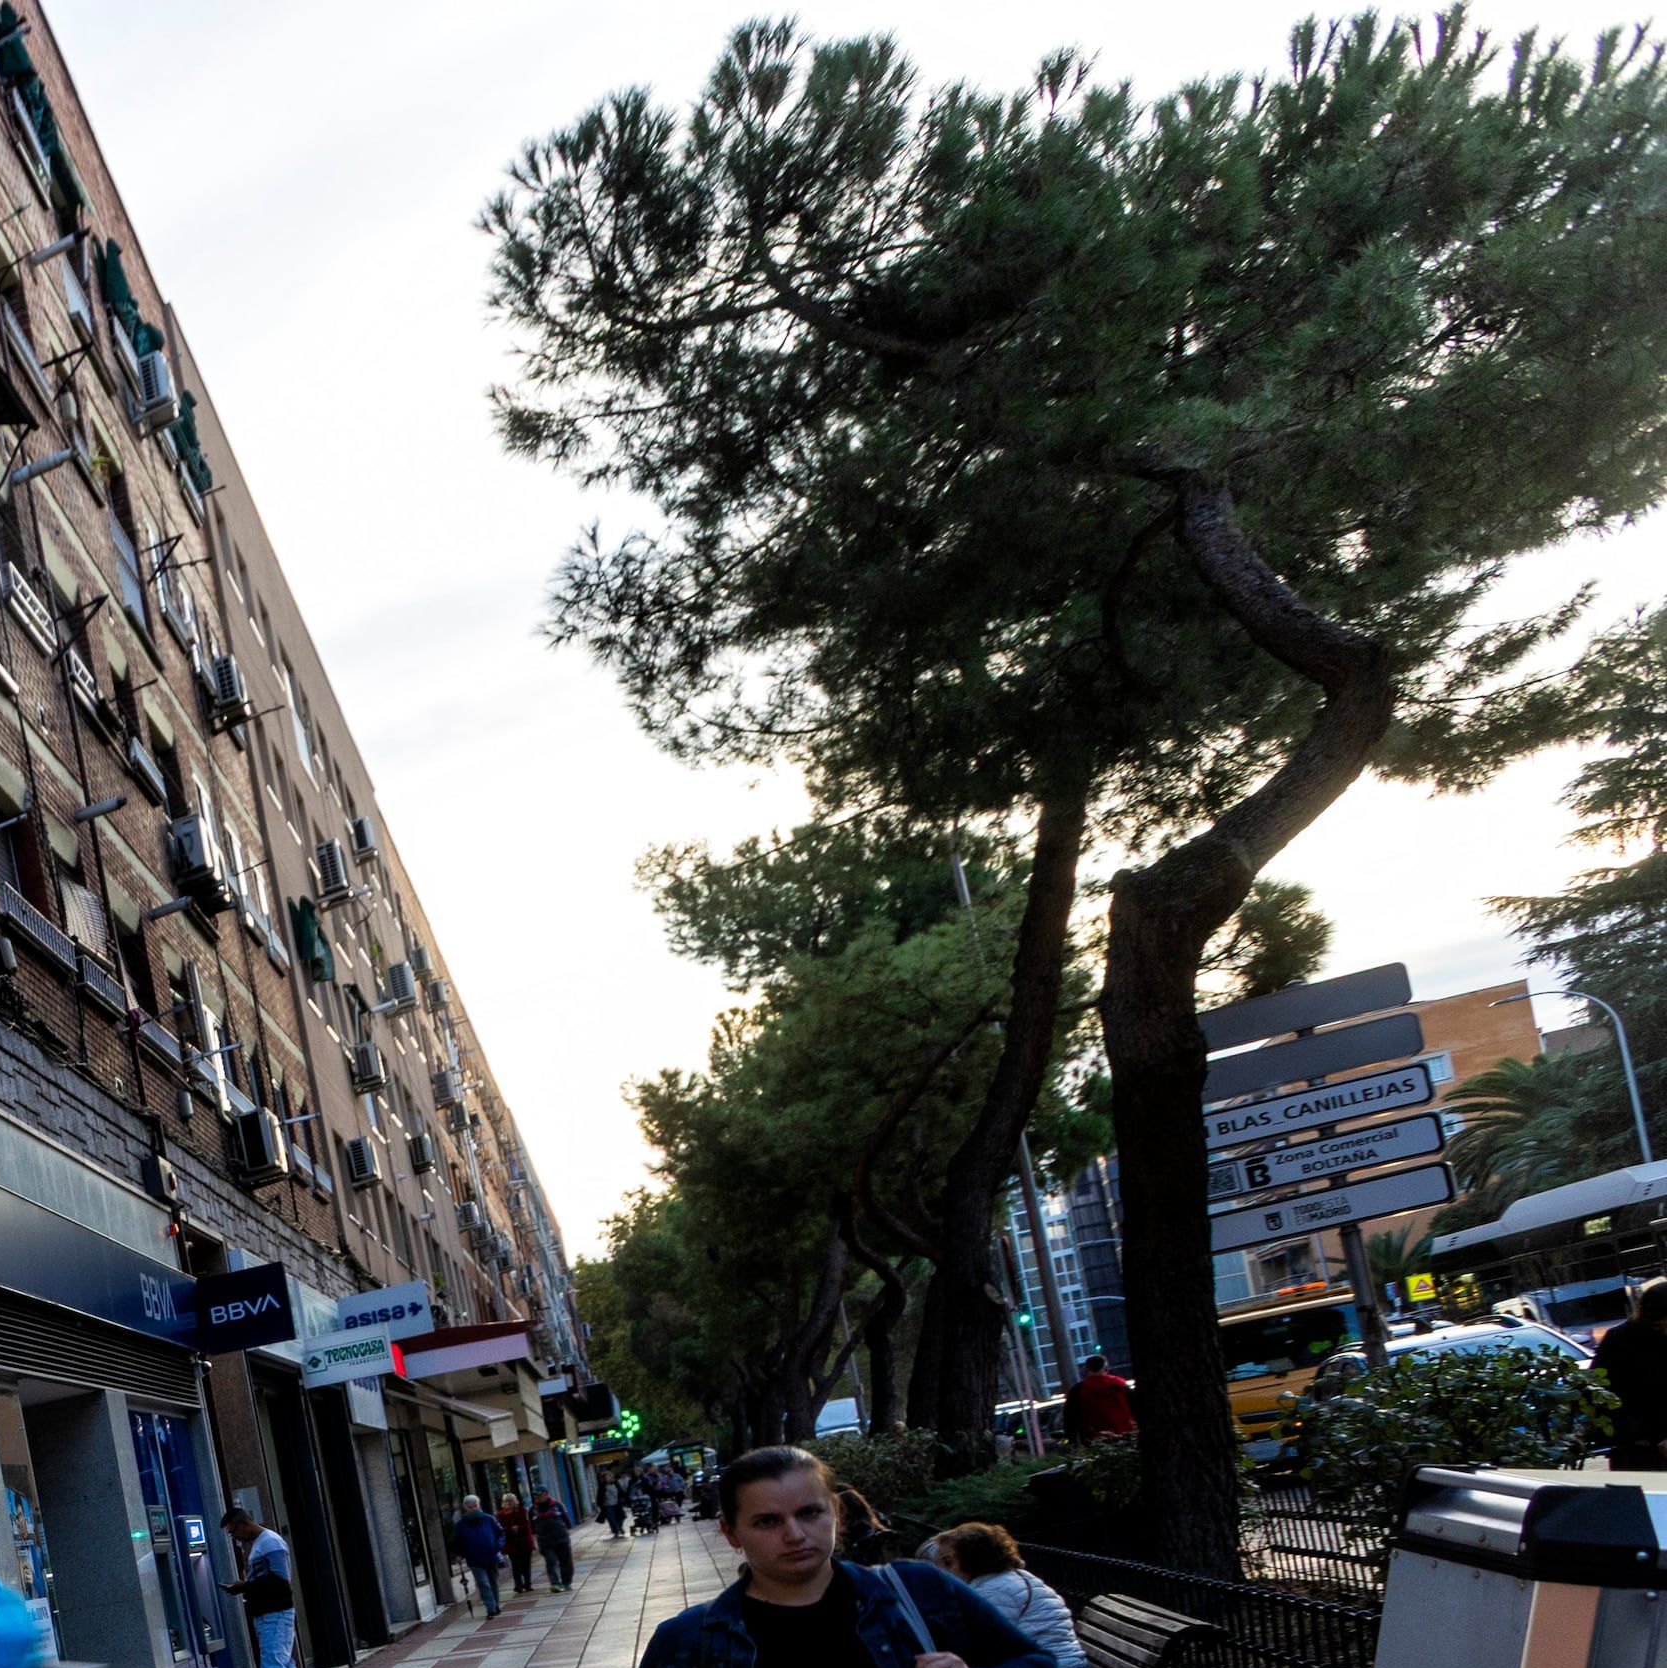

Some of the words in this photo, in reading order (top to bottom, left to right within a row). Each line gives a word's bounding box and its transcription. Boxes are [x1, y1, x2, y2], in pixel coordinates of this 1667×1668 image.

[1275, 1148, 1316, 1166] Zona
[1319, 1128, 1399, 1155] Comercial
[1302, 1149, 1379, 1175] BOLTAÑA
[139, 1272, 178, 1323] BBVA
[210, 1293, 281, 1325] BBVA
[324, 1337, 386, 1364] TECNOCASA
